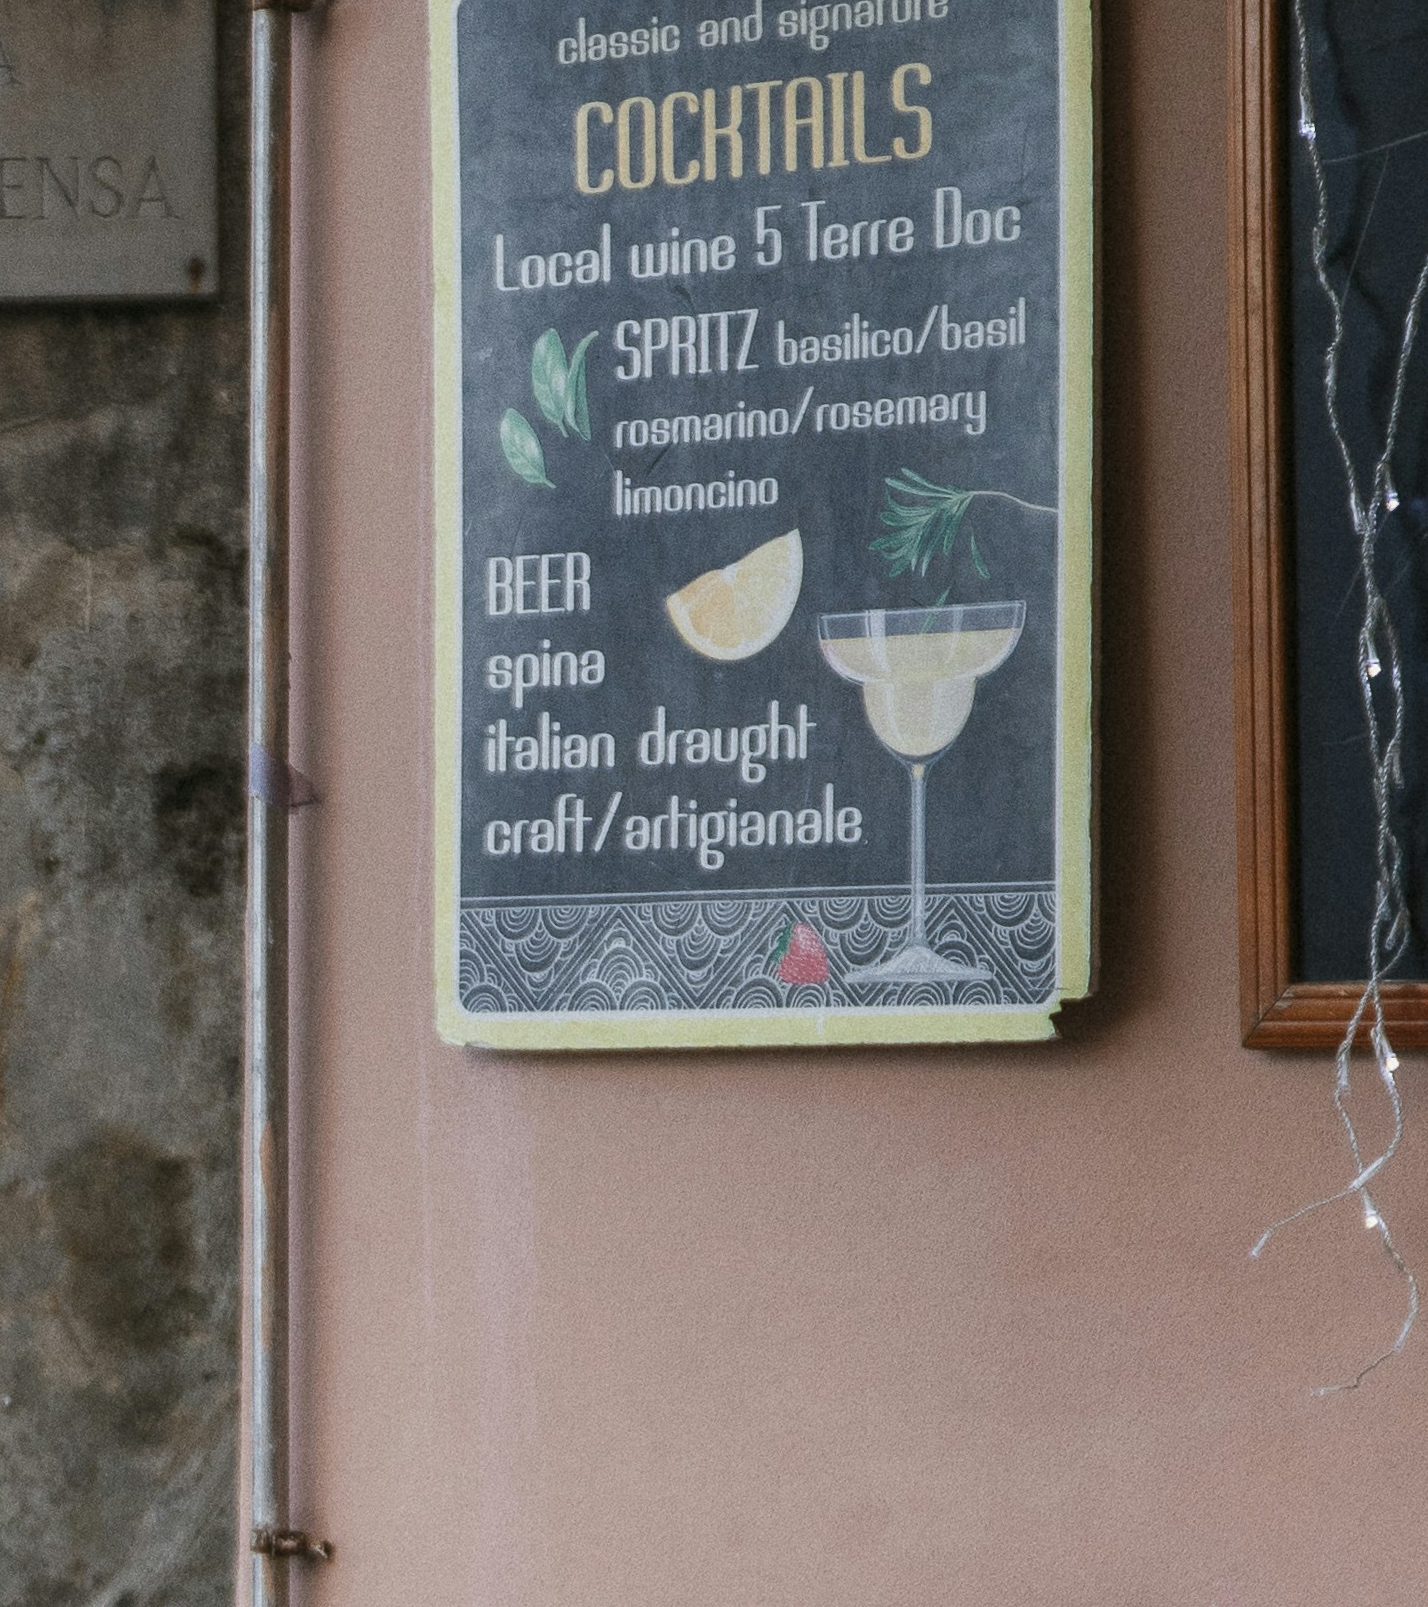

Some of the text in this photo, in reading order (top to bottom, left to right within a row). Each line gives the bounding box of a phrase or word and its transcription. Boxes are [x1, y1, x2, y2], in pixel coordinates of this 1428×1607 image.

[557, 17, 681, 65] classic
[574, 62, 934, 195] COCKTAILS
[494, 186, 1023, 292] Local wine 5 Terre Doc
[615, 307, 760, 381] SPRITZ
[615, 471, 779, 516] limoncino
[487, 552, 592, 617] BEER
[488, 640, 606, 708] spina
[486, 699, 818, 784] italian draught
